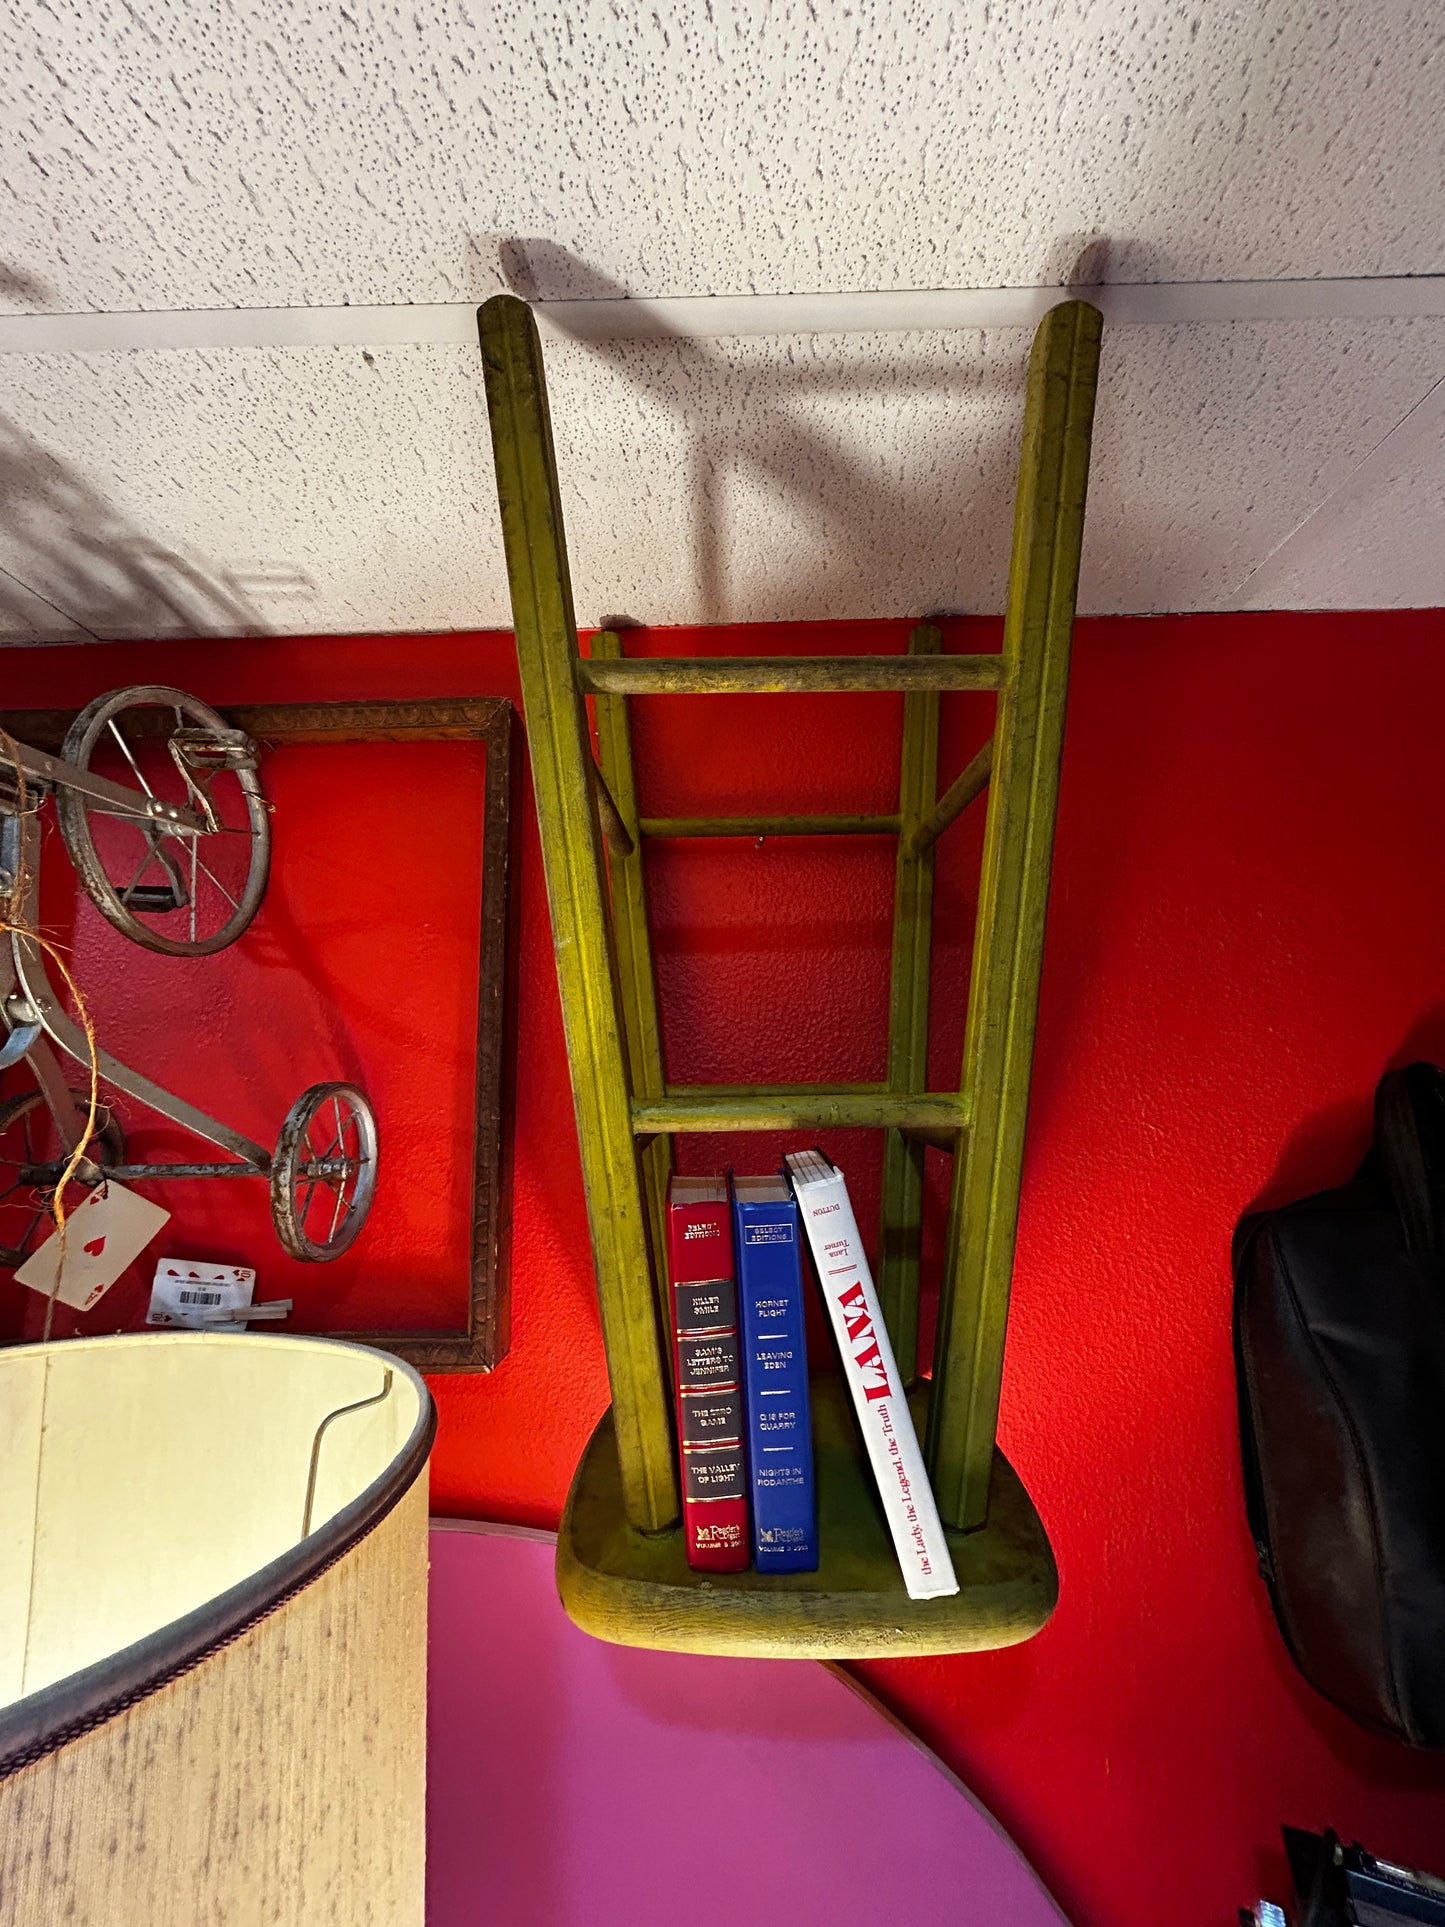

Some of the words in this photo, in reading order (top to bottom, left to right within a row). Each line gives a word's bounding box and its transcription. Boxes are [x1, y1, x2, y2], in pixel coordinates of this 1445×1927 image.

[812, 1203, 840, 1217] DUTTON
[751, 1234, 787, 1242] EDITIONS
[824, 1239, 850, 1251] Turner
[828, 1249, 849, 1258] Lana
[692, 1296, 719, 1306] KILLER
[755, 1299, 789, 1308] HORNET
[693, 1305, 719, 1315] SMILE
[758, 1309, 787, 1318] FLIGHT
[838, 1281, 892, 1403] LANA
[686, 1356, 721, 1367] LETTERS
[722, 1354, 734, 1363] TO
[756, 1351, 793, 1361] LEAVING
[690, 1365, 730, 1376] JENNIFER
[764, 1361, 786, 1370] EDEN
[692, 1409, 709, 1418] THE
[760, 1413, 767, 1421] Q
[768, 1413, 777, 1421] IS
[778, 1412, 796, 1420] FOR
[877, 1403, 893, 1437] Truth
[760, 1422, 796, 1431] QUARRY
[888, 1439, 901, 1456] the
[691, 1467, 707, 1475] THE
[708, 1463, 740, 1474] VALLEY
[759, 1468, 790, 1476] NIGHTS
[792, 1467, 802, 1475] IN
[698, 1475, 710, 1484] OF
[711, 1473, 735, 1483] LIGHT
[757, 1478, 804, 1487] RODANTHE
[907, 1504, 918, 1522] the
[921, 1557, 932, 1576] the
